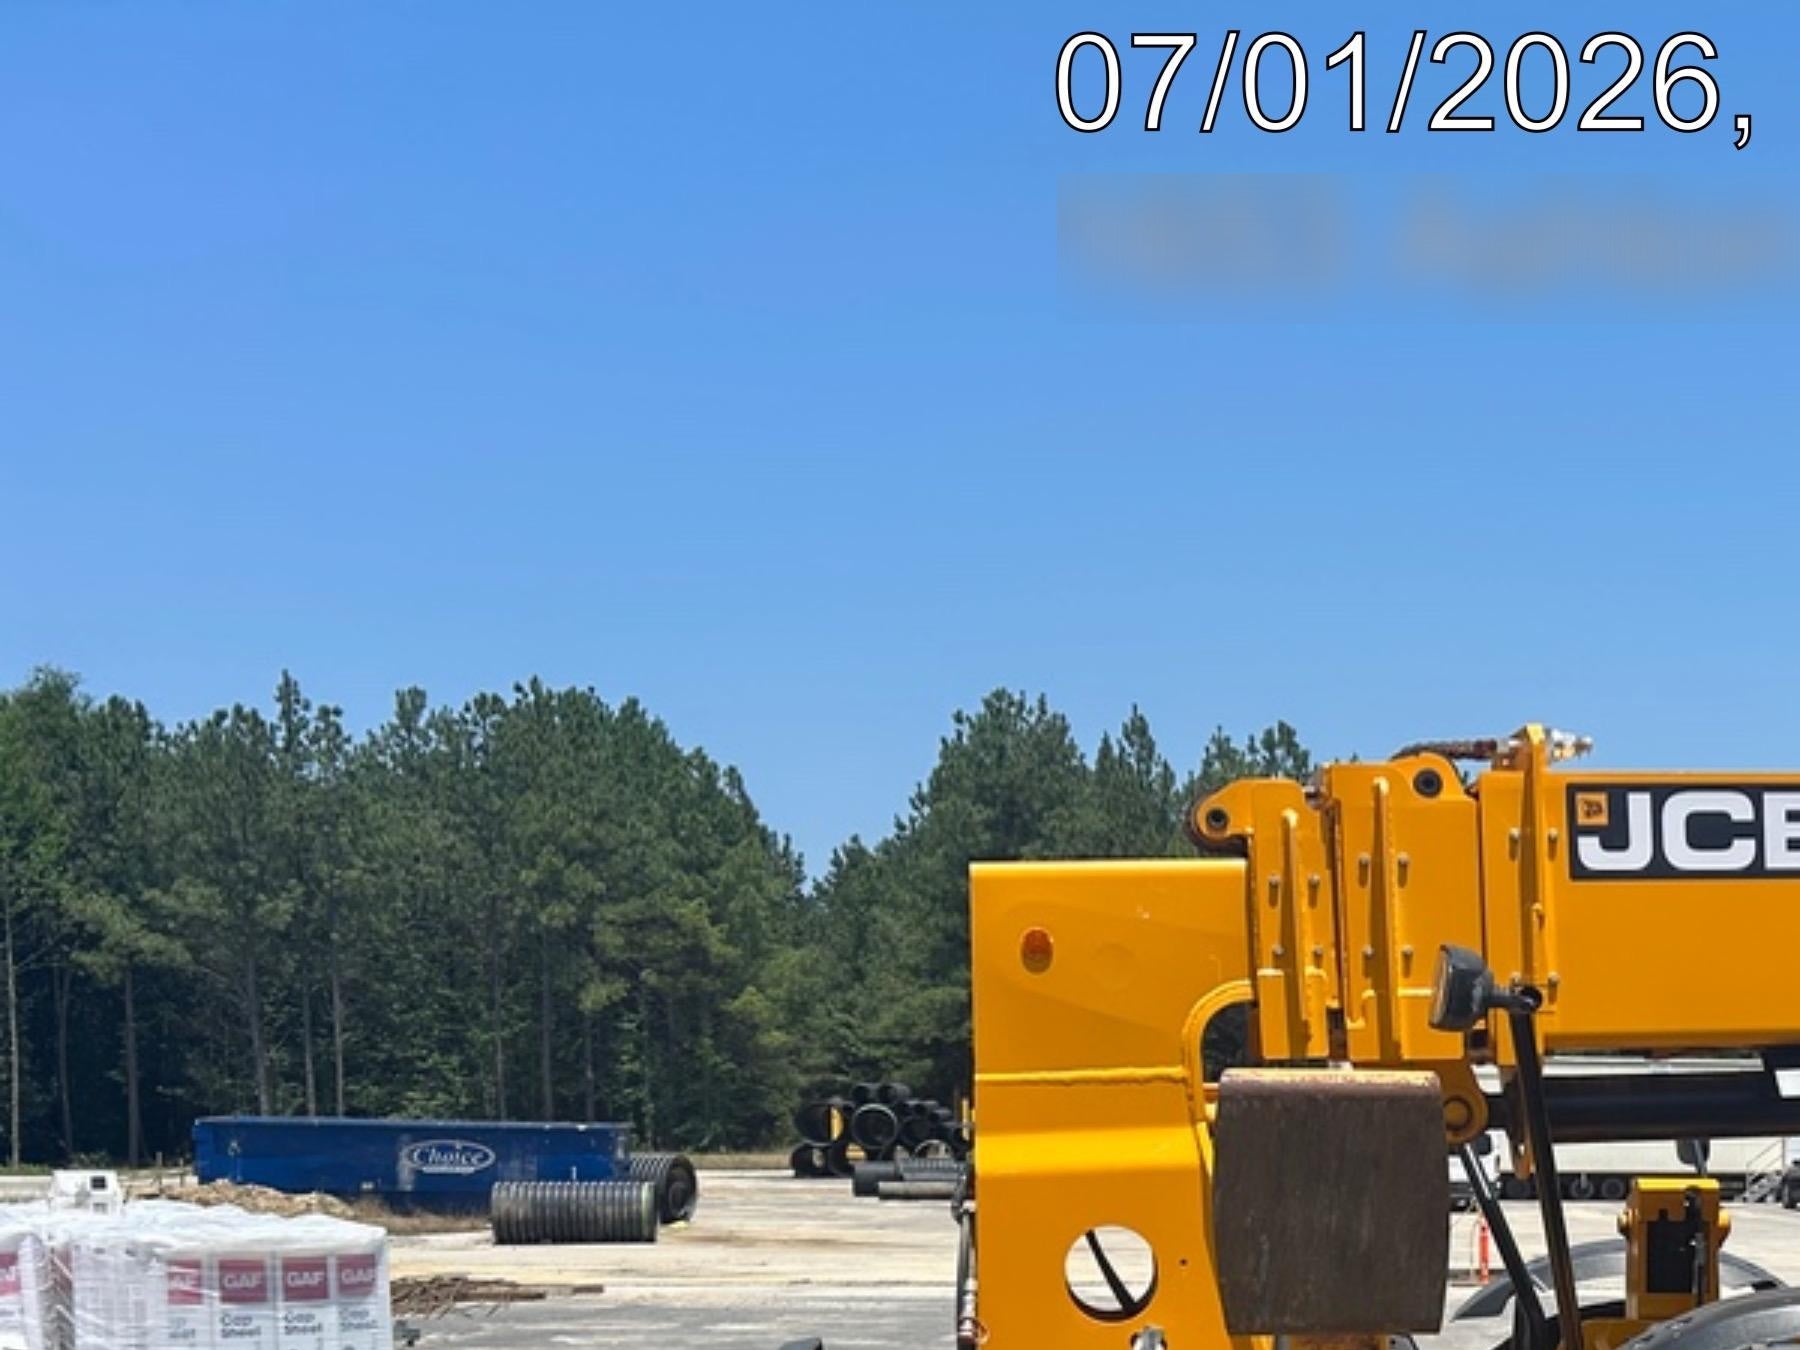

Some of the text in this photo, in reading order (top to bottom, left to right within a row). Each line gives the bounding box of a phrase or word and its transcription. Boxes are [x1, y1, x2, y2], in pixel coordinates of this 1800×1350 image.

[413, 1143, 485, 1165] Choice
[223, 1272, 263, 1289] GAF
[286, 1270, 326, 1287] GAF
[220, 1313, 253, 1327] Cap
[284, 1311, 316, 1323] Cap
[220, 1325, 262, 1339] Sheet
[284, 1322, 322, 1336] Sheet
